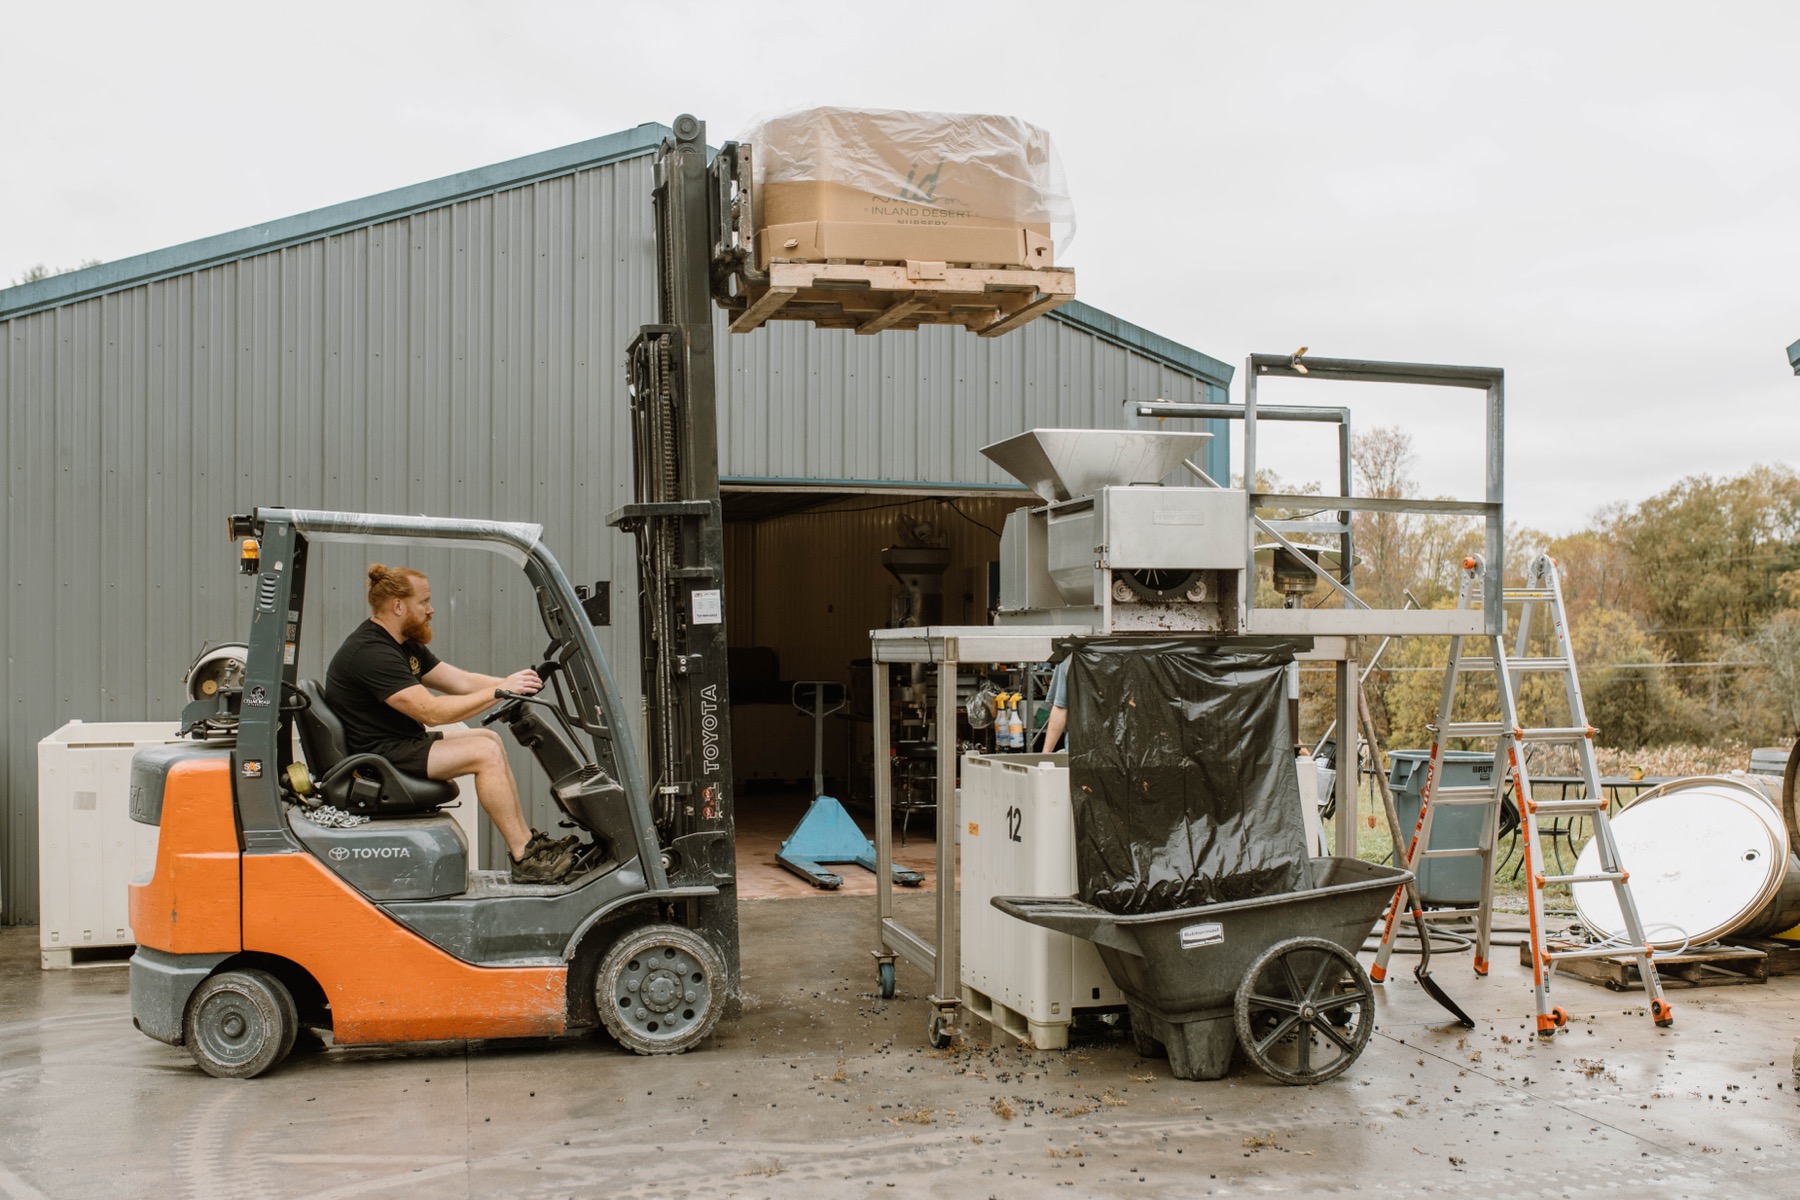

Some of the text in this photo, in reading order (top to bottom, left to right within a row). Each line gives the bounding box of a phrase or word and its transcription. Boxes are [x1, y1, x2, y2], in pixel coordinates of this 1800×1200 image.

[871, 206, 973, 219] INLAND DESERT
[701, 684, 720, 775] TOYOTA
[243, 761, 262, 772] SAS
[1422, 768, 1433, 809] TITAN
[1006, 805, 1022, 843] 12
[351, 847, 411, 859] TOYOTA
